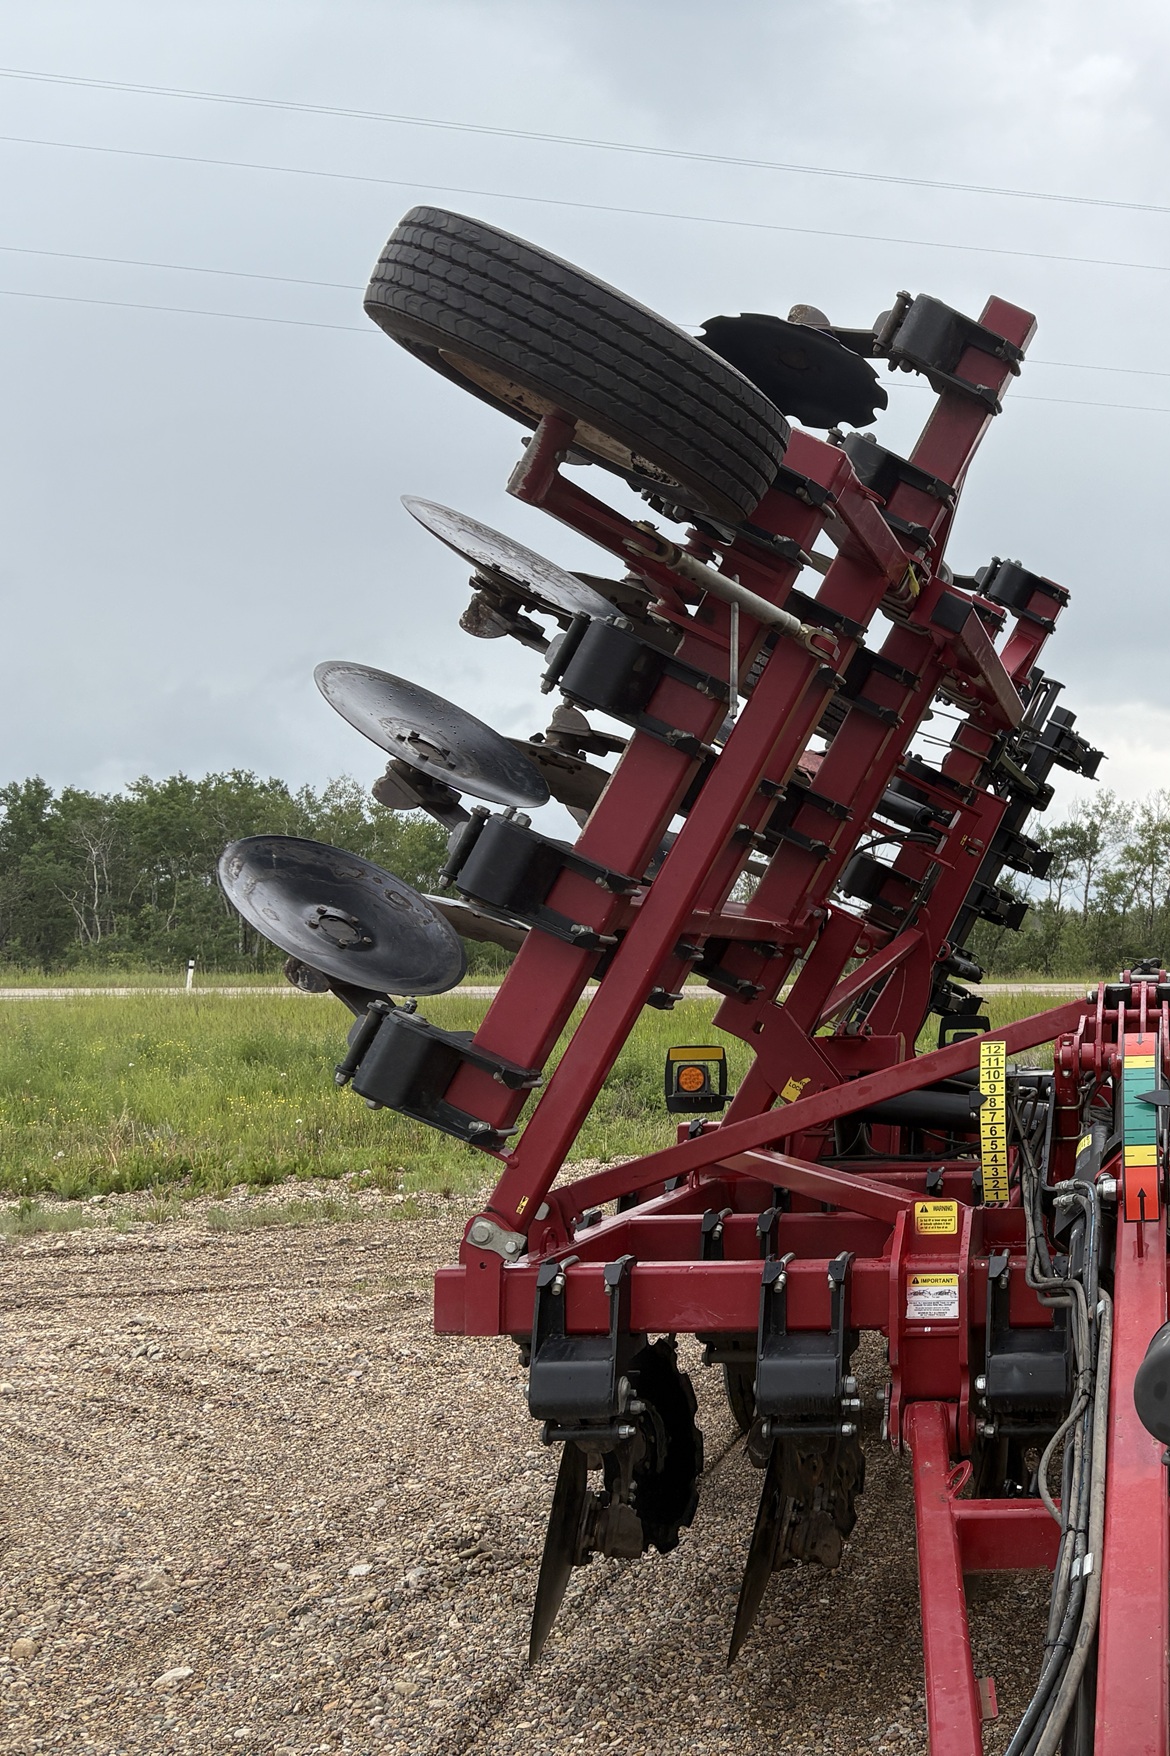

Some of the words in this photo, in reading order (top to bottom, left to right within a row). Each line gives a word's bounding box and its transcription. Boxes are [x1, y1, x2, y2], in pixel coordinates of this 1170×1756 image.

[986, 1045, 1001, 1054] 12
[985, 1057, 999, 1067] 11
[985, 1070, 1000, 1080] 10
[988, 1083, 997, 1094] 9
[988, 1097, 997, 1108] 8
[989, 1111, 997, 1122] 7
[989, 1126, 997, 1136] 6
[990, 1140, 998, 1150] 5
[990, 1154, 999, 1163] 4
[991, 1167, 999, 1177] 3
[992, 1179, 1000, 1189] 2
[993, 1191, 999, 1200] 1
